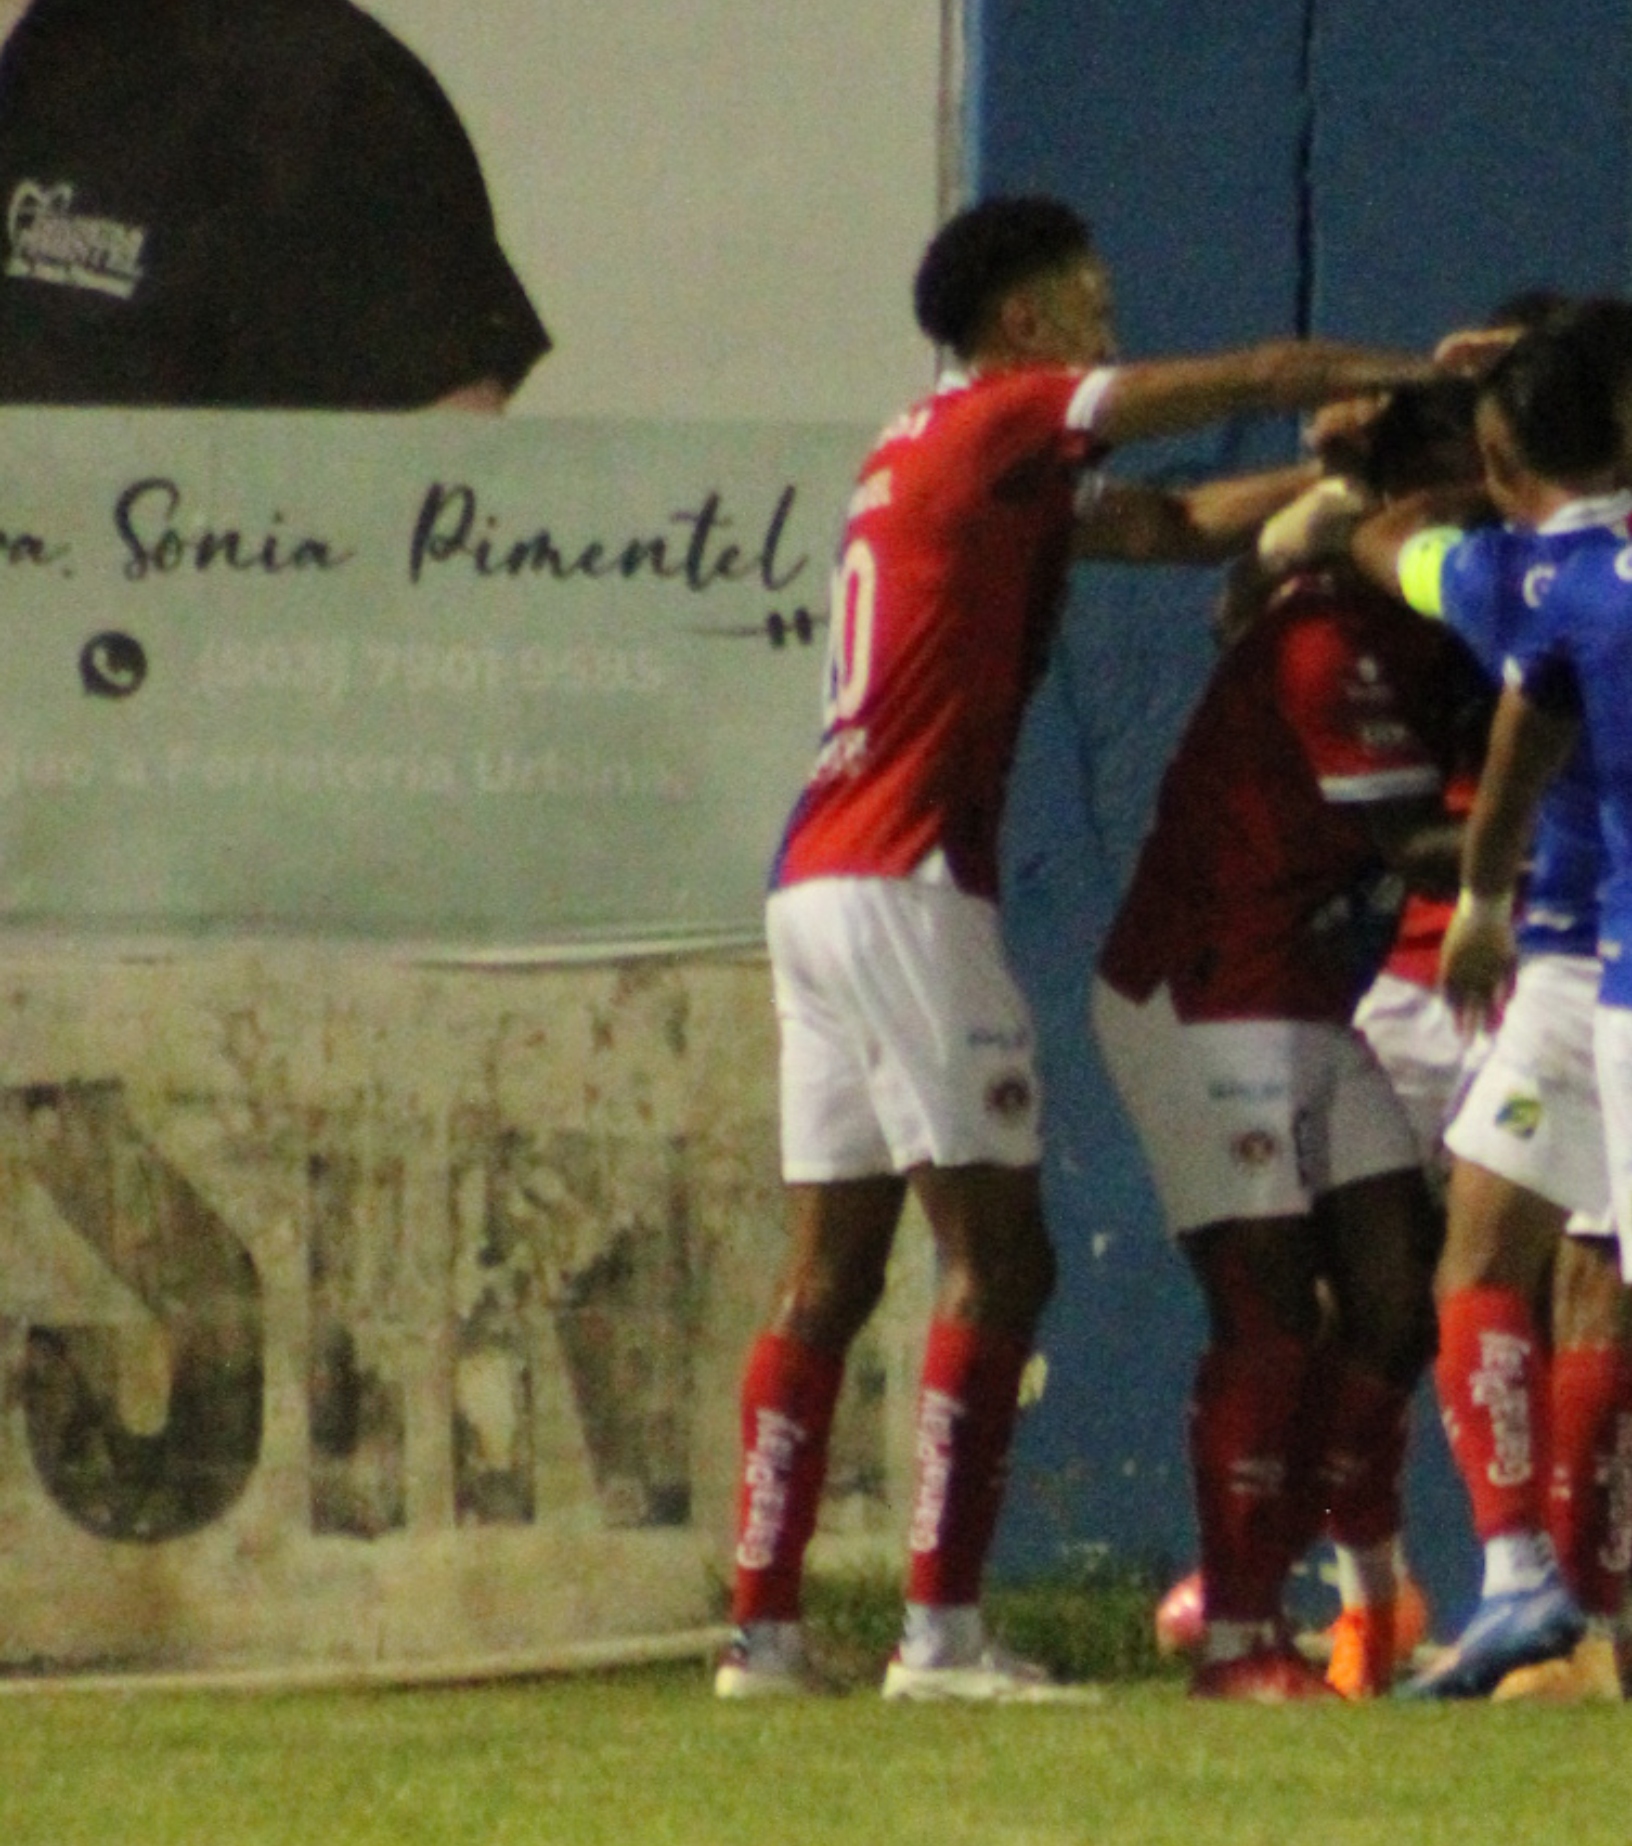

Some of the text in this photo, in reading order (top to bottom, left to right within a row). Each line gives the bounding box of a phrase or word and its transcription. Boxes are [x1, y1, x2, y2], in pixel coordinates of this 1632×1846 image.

[0, 531, 73, 580] a.
[113, 478, 352, 582] Sonia
[410, 482, 810, 592] Pimentel
